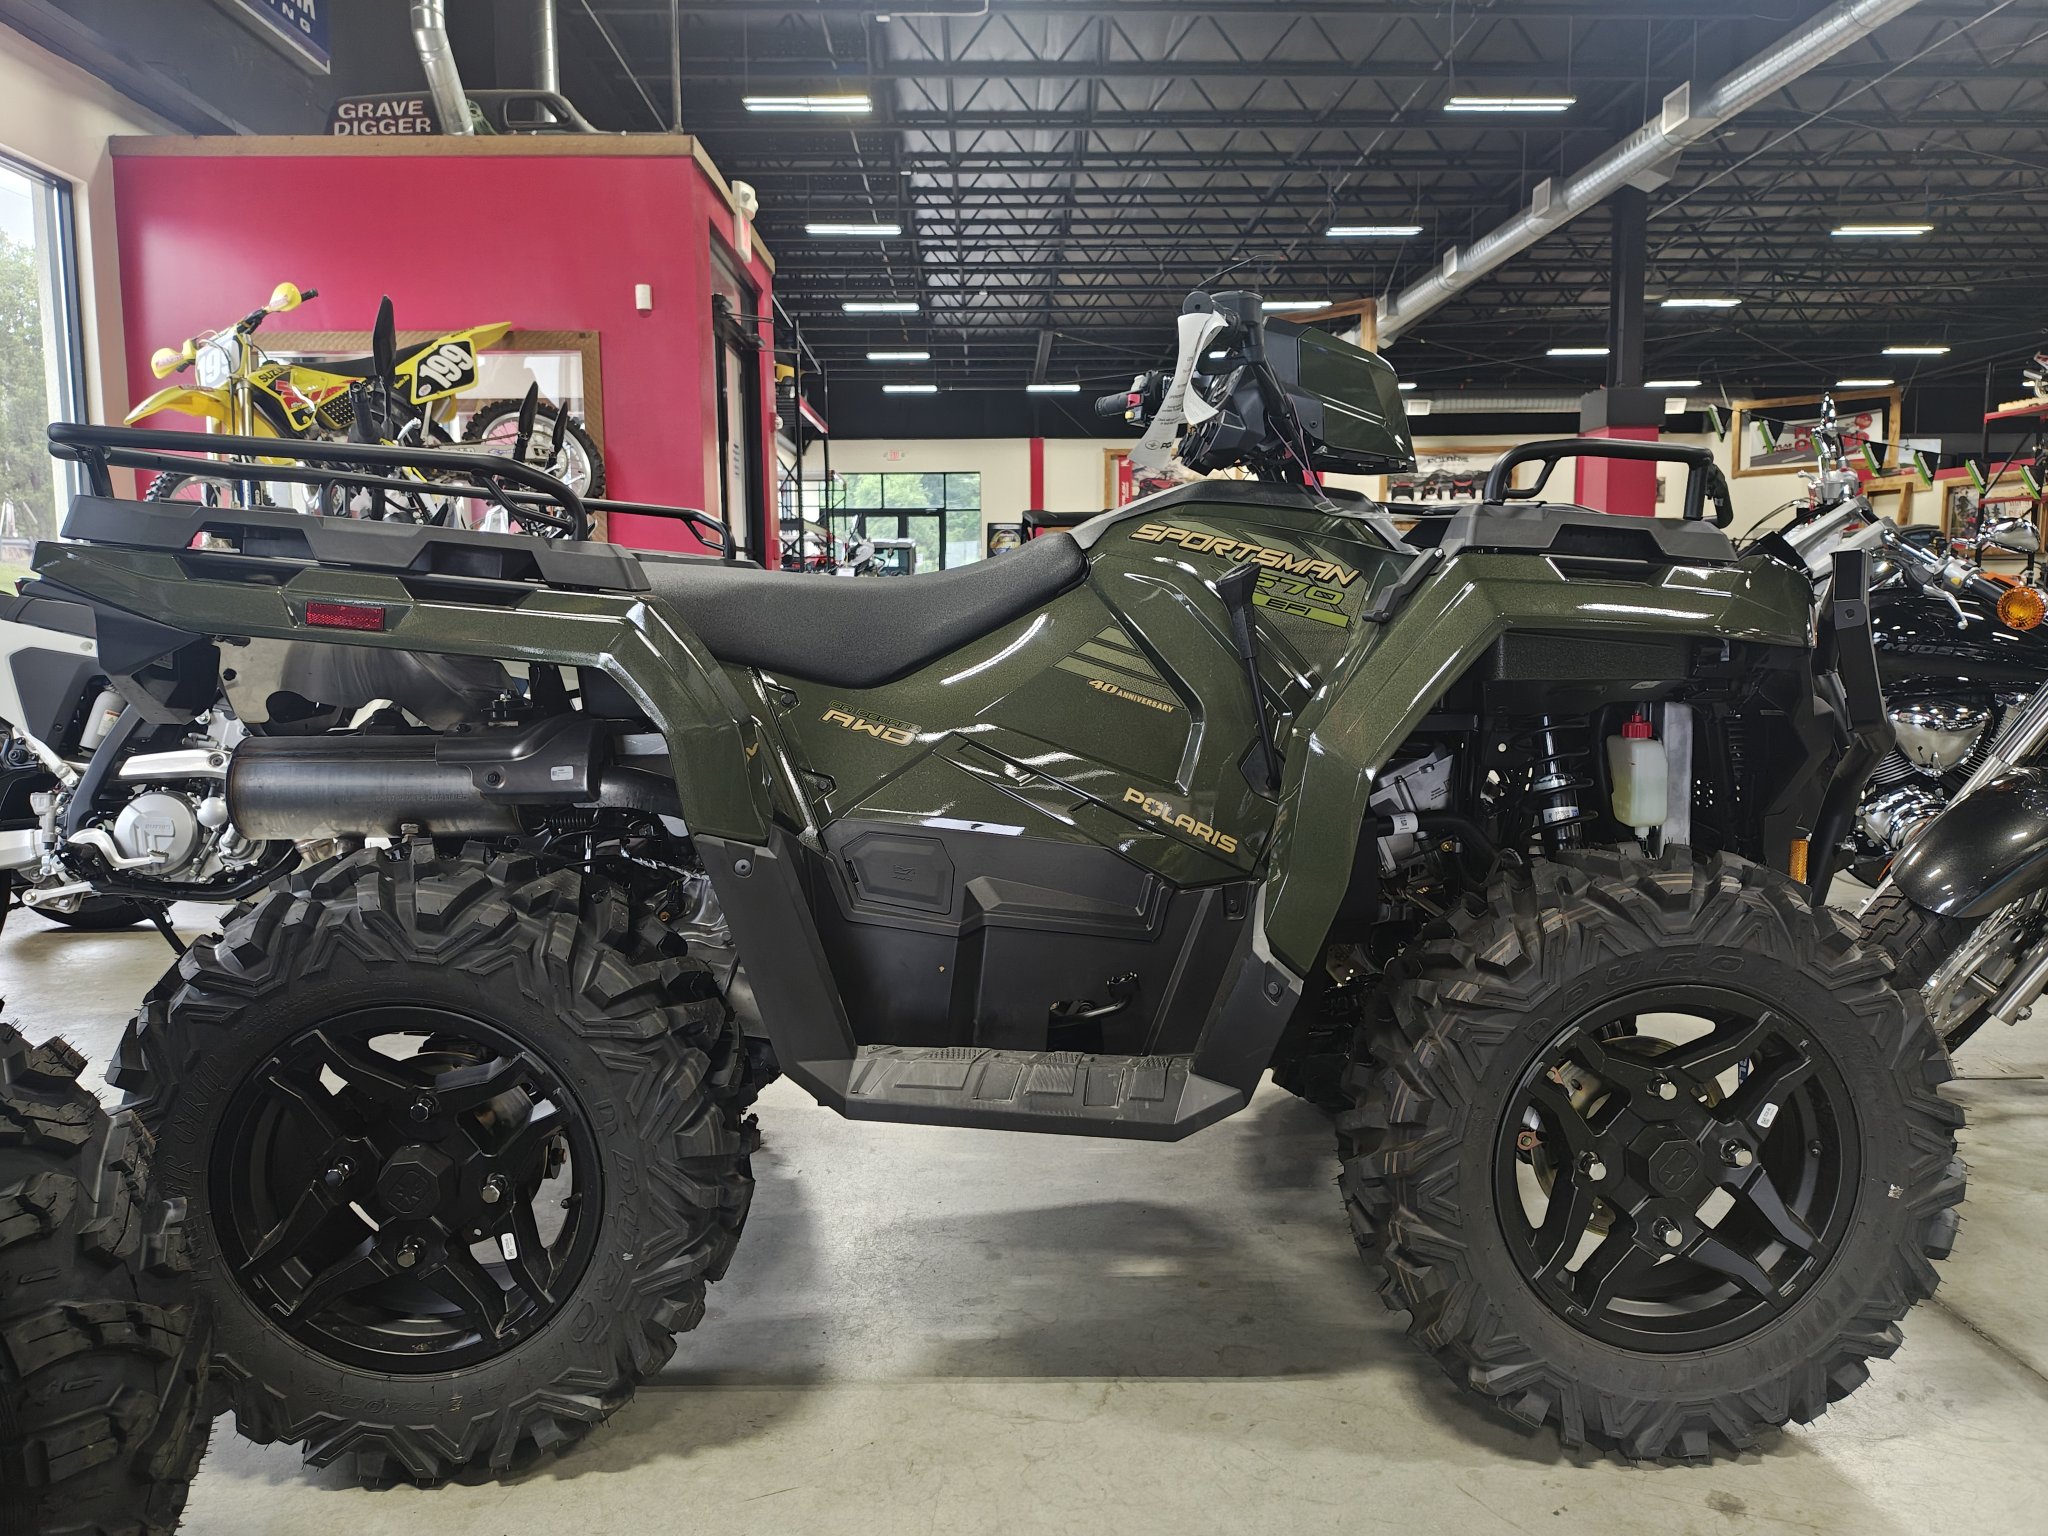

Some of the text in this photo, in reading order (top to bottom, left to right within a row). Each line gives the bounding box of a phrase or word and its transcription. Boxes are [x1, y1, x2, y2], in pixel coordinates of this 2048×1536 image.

[338, 100, 424, 119] GRAVE
[334, 118, 431, 136] DIGGER
[419, 344, 474, 389] 199
[1130, 523, 1362, 588] SPORTSMAN
[1256, 573, 1345, 606] 570
[1266, 598, 1311, 616] EFI
[829, 700, 854, 713] ON
[1089, 680, 1174, 713] 40 ANNIVERSARY
[820, 708, 917, 746] AWD
[1122, 787, 1238, 854] POLARIS
[1562, 953, 1745, 1013] DURO
